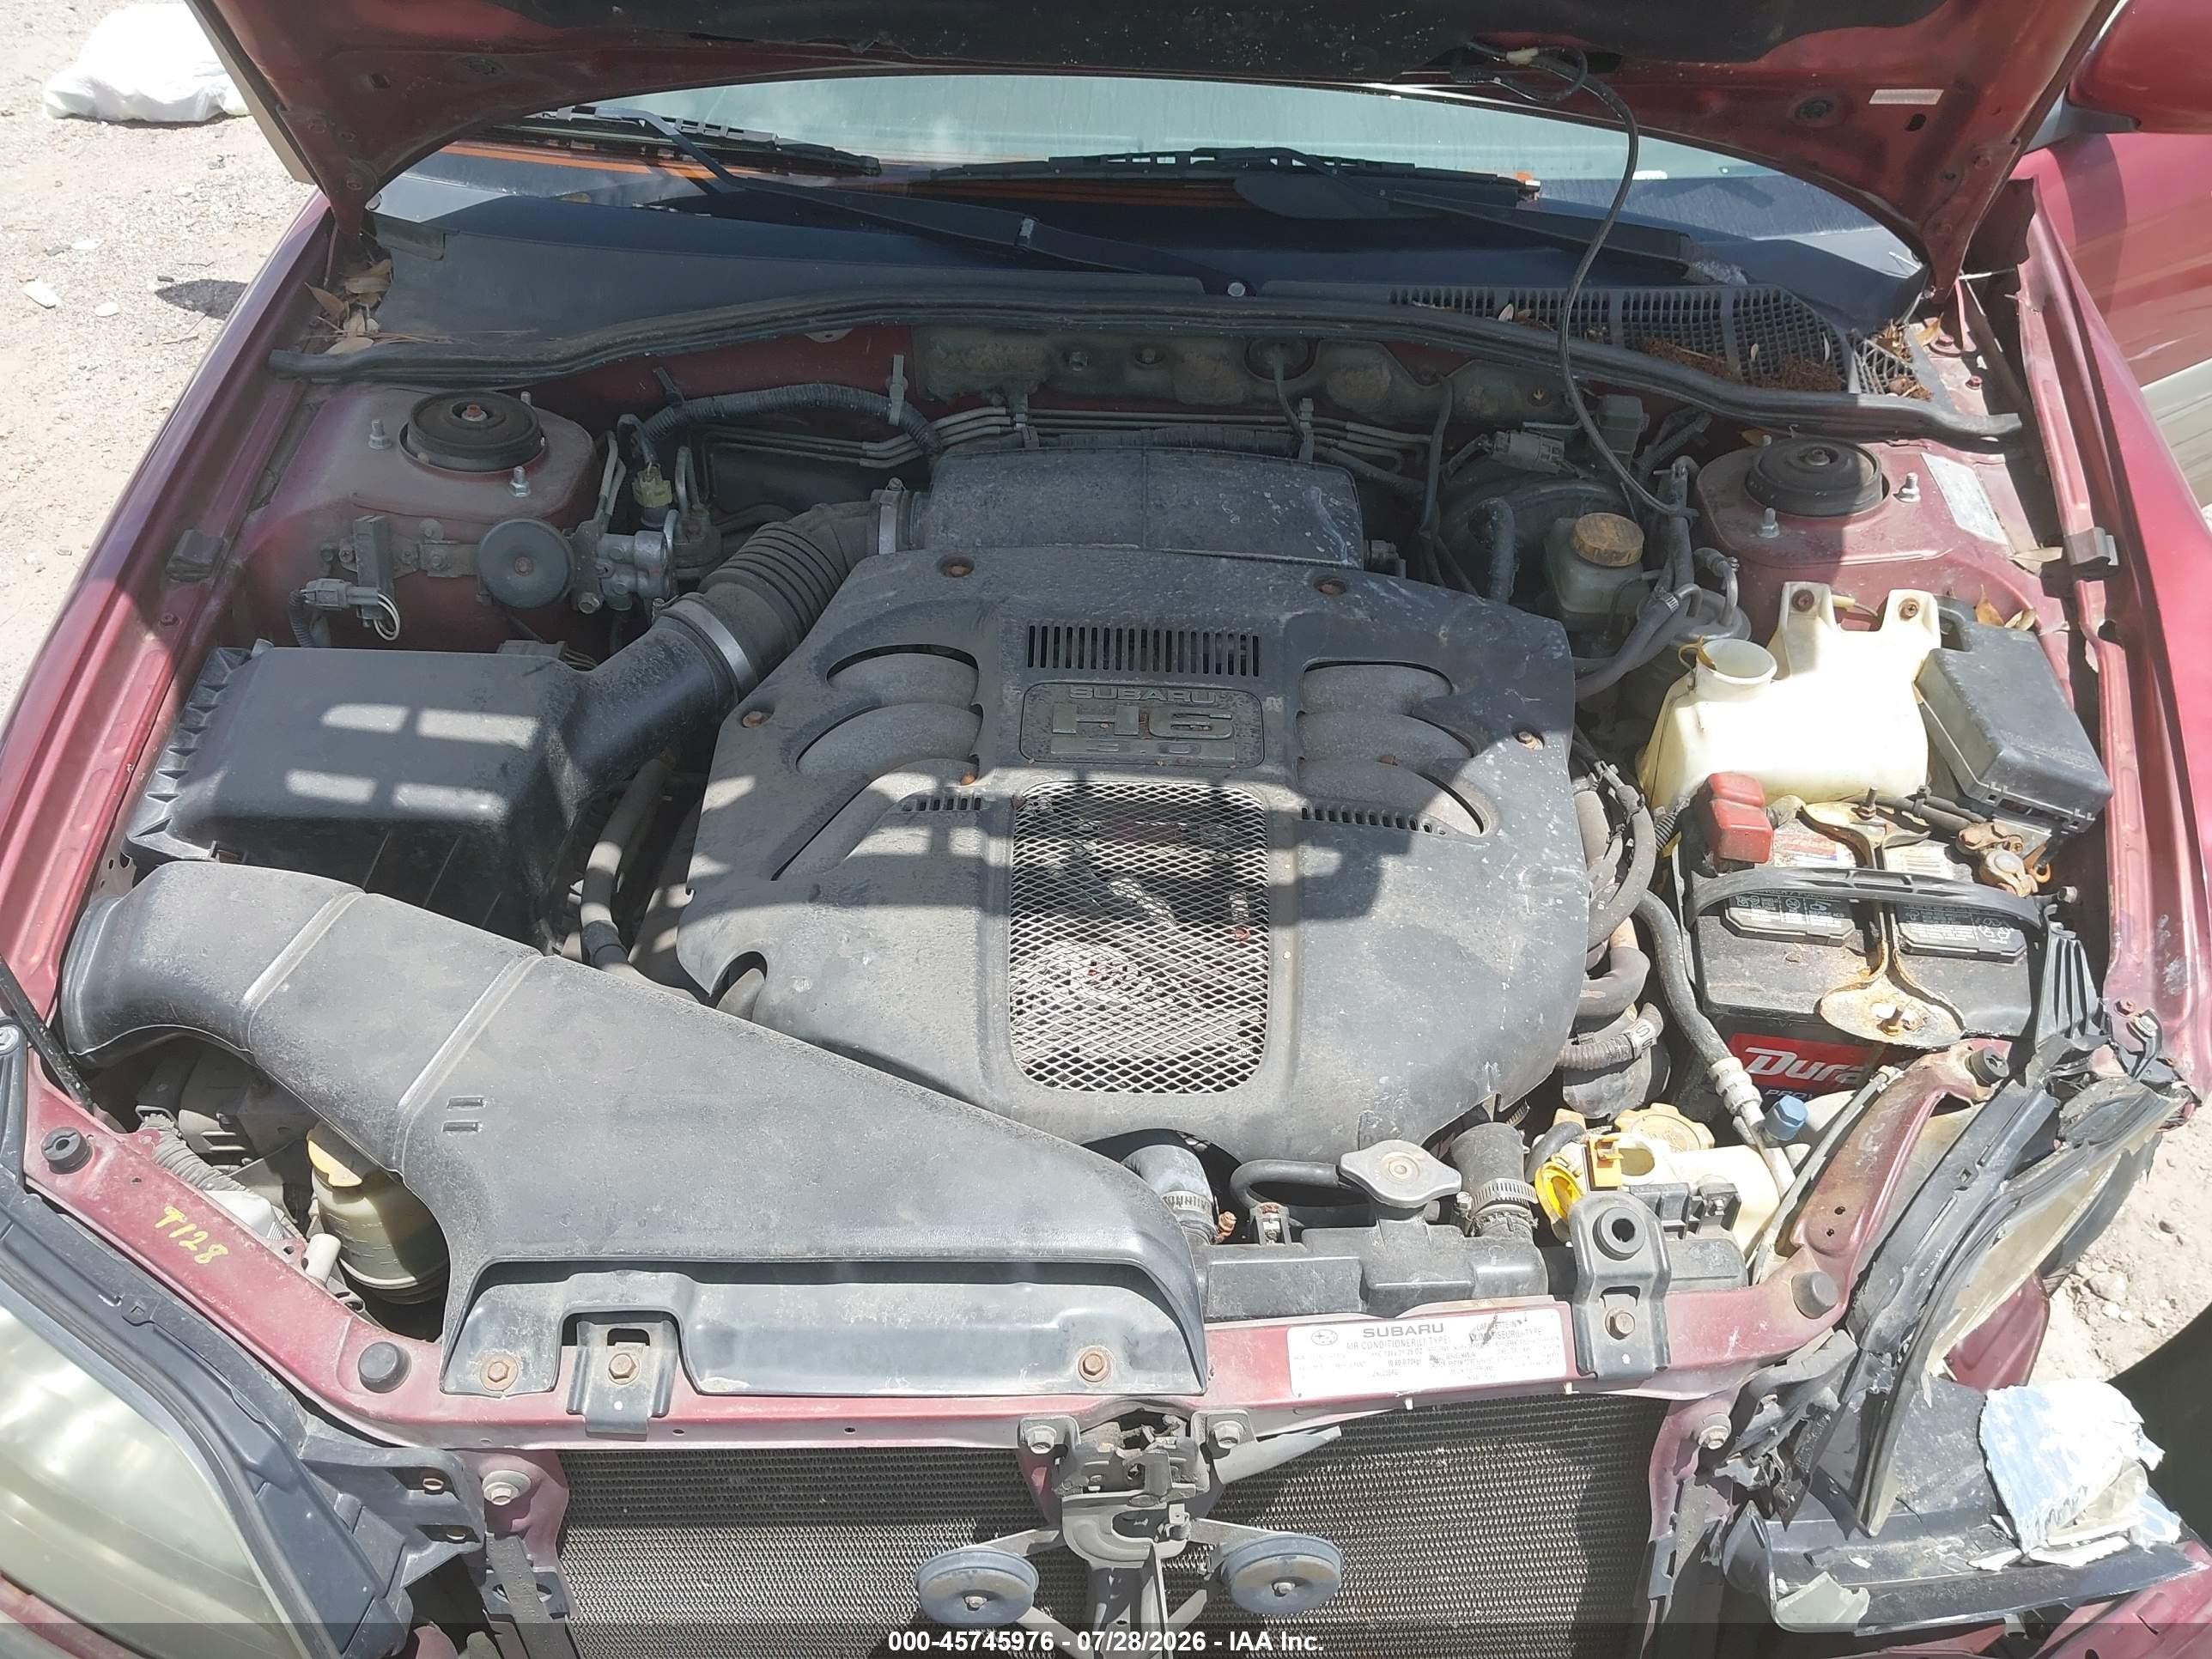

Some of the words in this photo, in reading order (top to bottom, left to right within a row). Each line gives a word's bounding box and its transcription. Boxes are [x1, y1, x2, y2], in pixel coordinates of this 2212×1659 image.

[1070, 686, 1217, 704] SUBARU
[1052, 704, 1234, 740] H6
[155, 1206, 228, 1264] T128
[1362, 1322, 1444, 1339] SUBARU
